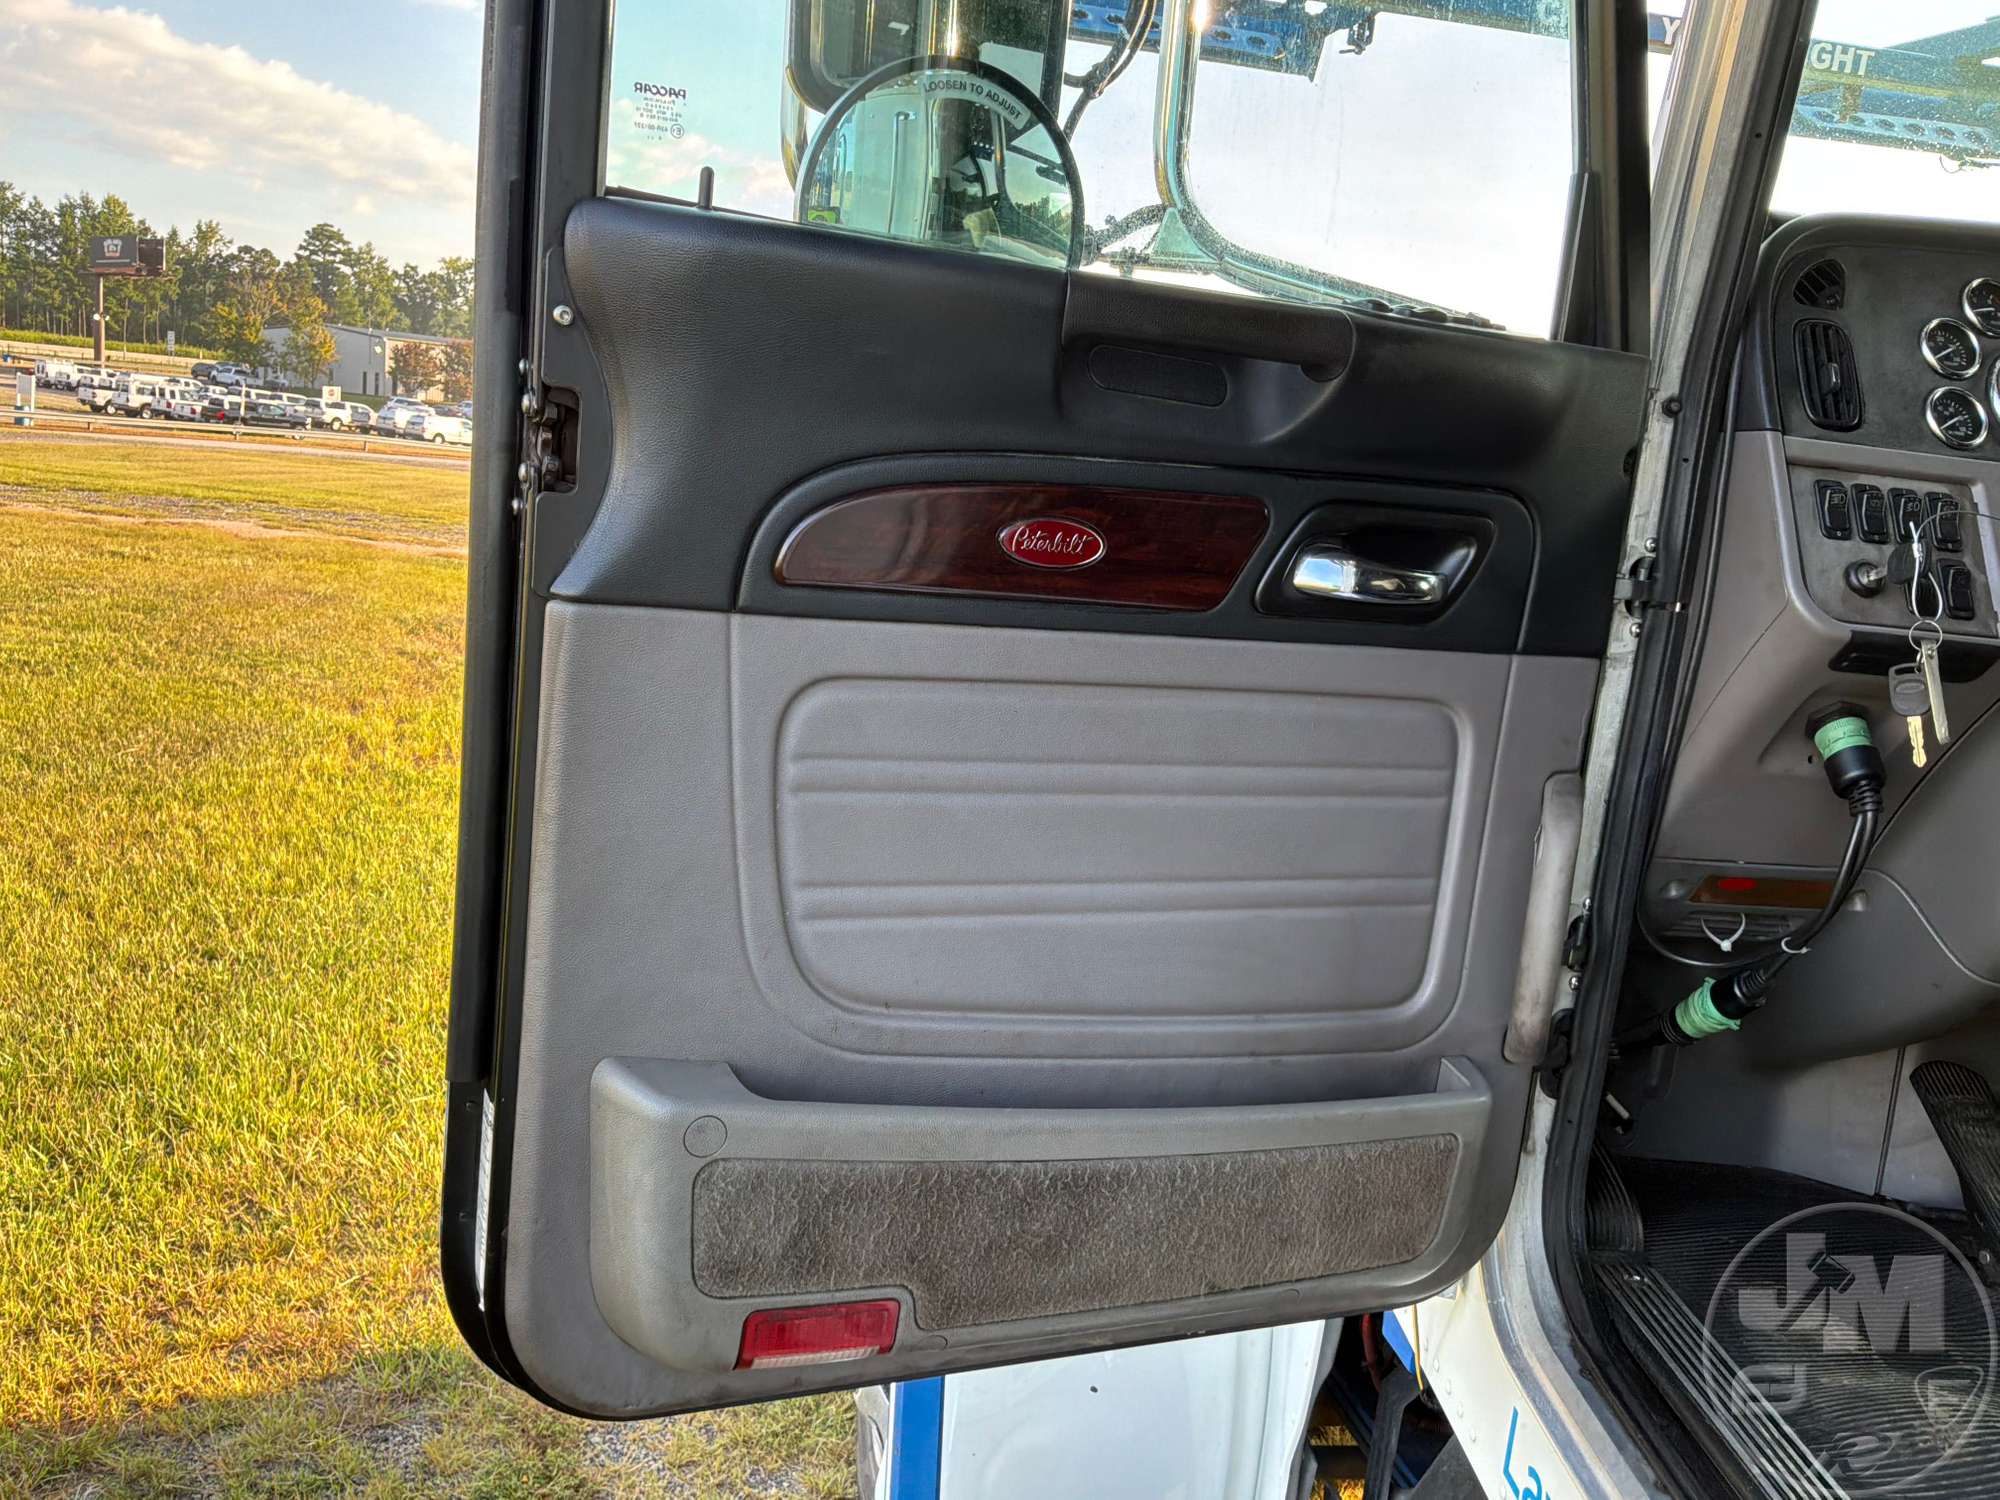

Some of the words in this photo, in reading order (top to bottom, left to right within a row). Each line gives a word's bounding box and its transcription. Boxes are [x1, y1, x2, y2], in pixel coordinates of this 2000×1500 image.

[1810, 42, 1875, 76] GHT
[924, 79, 967, 93] LOOSEN
[970, 83, 984, 96] TO
[985, 89, 1023, 120] ADJUST
[1011, 525, 1095, 555] Peterbilt
